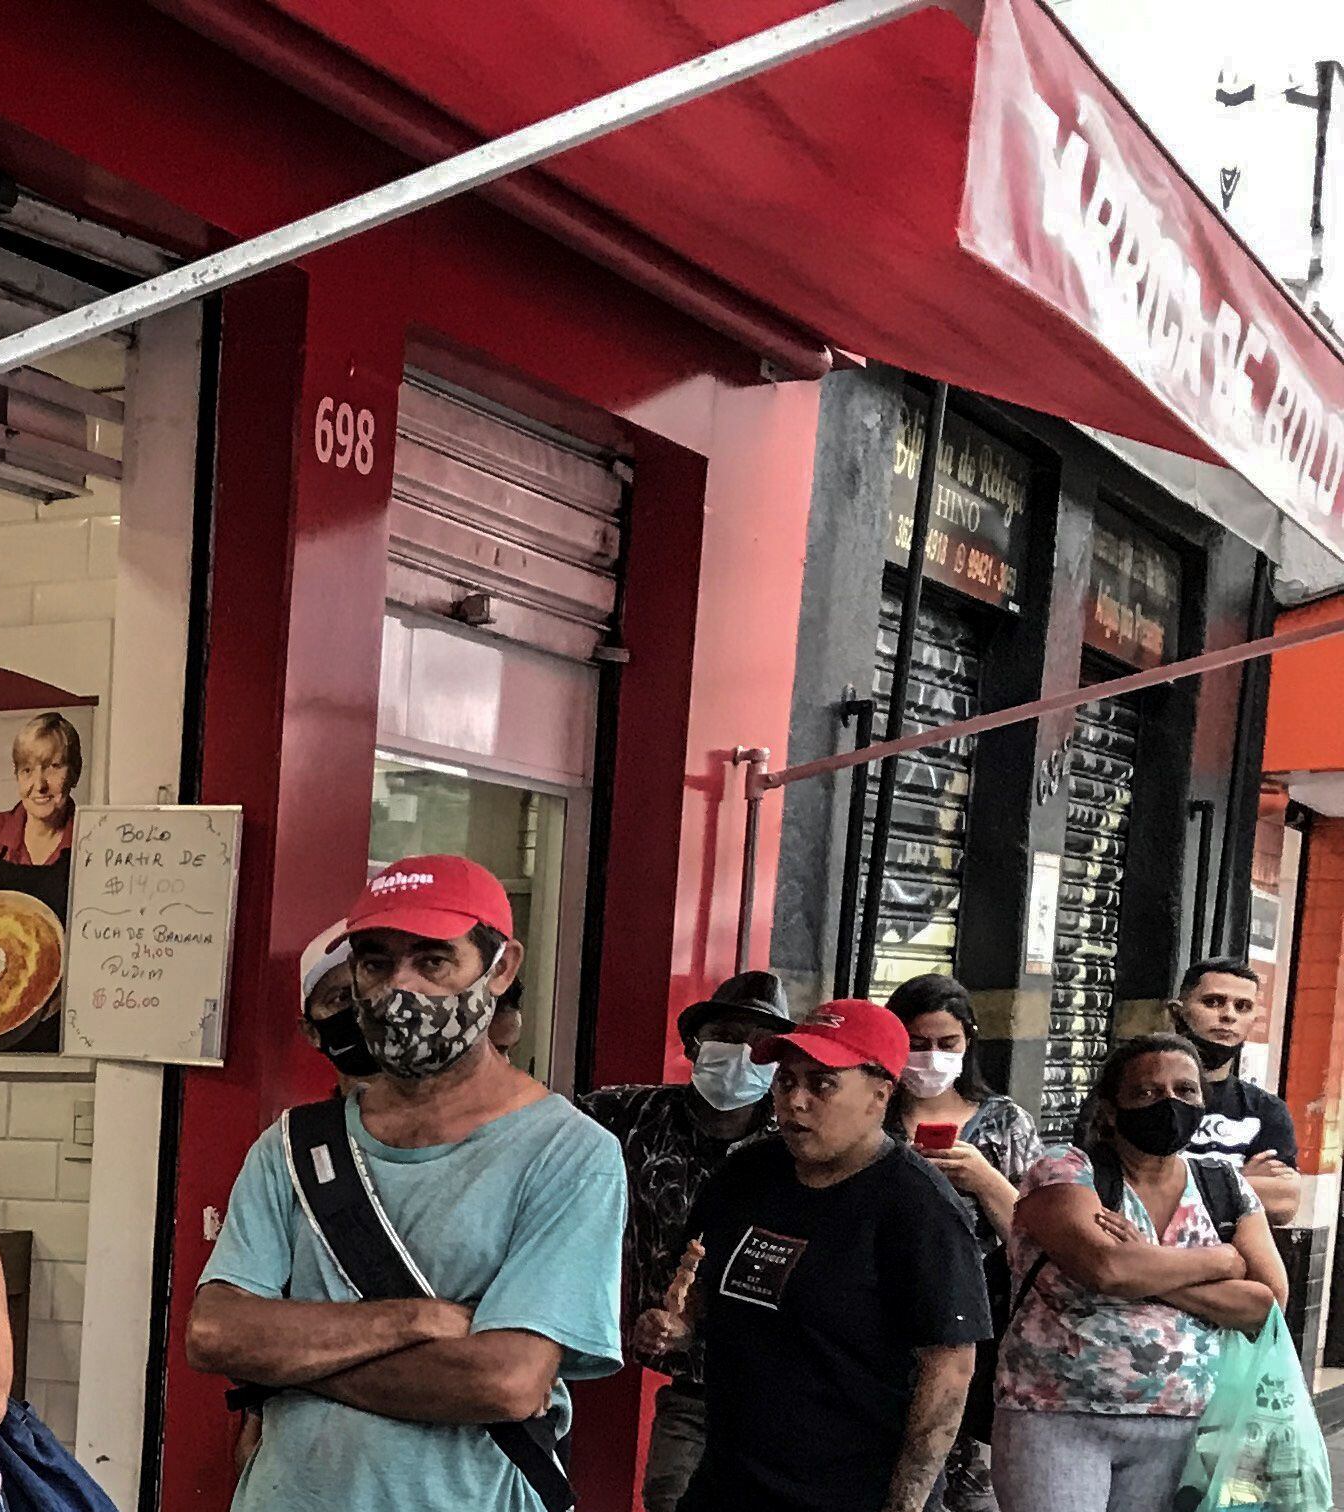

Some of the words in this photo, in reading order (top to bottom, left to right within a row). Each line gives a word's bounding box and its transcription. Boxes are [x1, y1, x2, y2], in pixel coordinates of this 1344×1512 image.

[315, 396, 375, 475] 698
[935, 483, 981, 533] HINO
[179, 850, 207, 867] DE
[128, 928, 145, 940] DE
